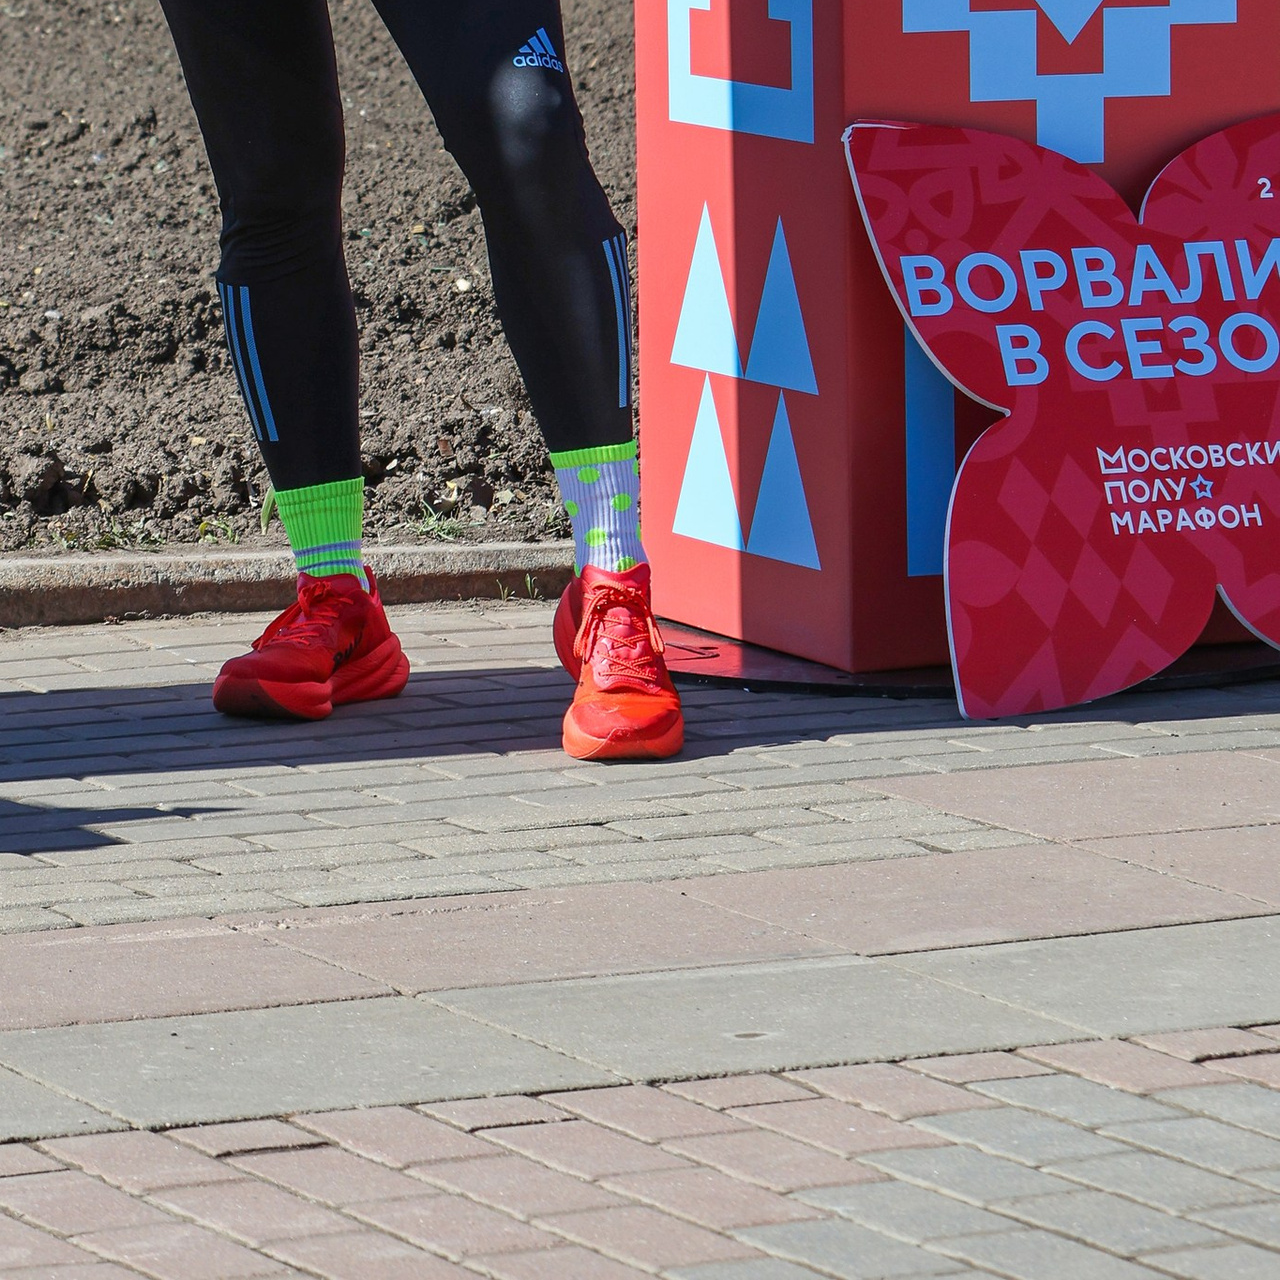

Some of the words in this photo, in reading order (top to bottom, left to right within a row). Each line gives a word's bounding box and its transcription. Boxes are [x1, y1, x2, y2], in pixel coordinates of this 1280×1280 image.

[513, 52, 564, 73] adidas
[995, 324, 1050, 387] В
[1064, 311, 1280, 382] СЕЗО
[1104, 477, 1187, 505] ПОЛУ
[1110, 503, 1263, 535] МАРАФОН
